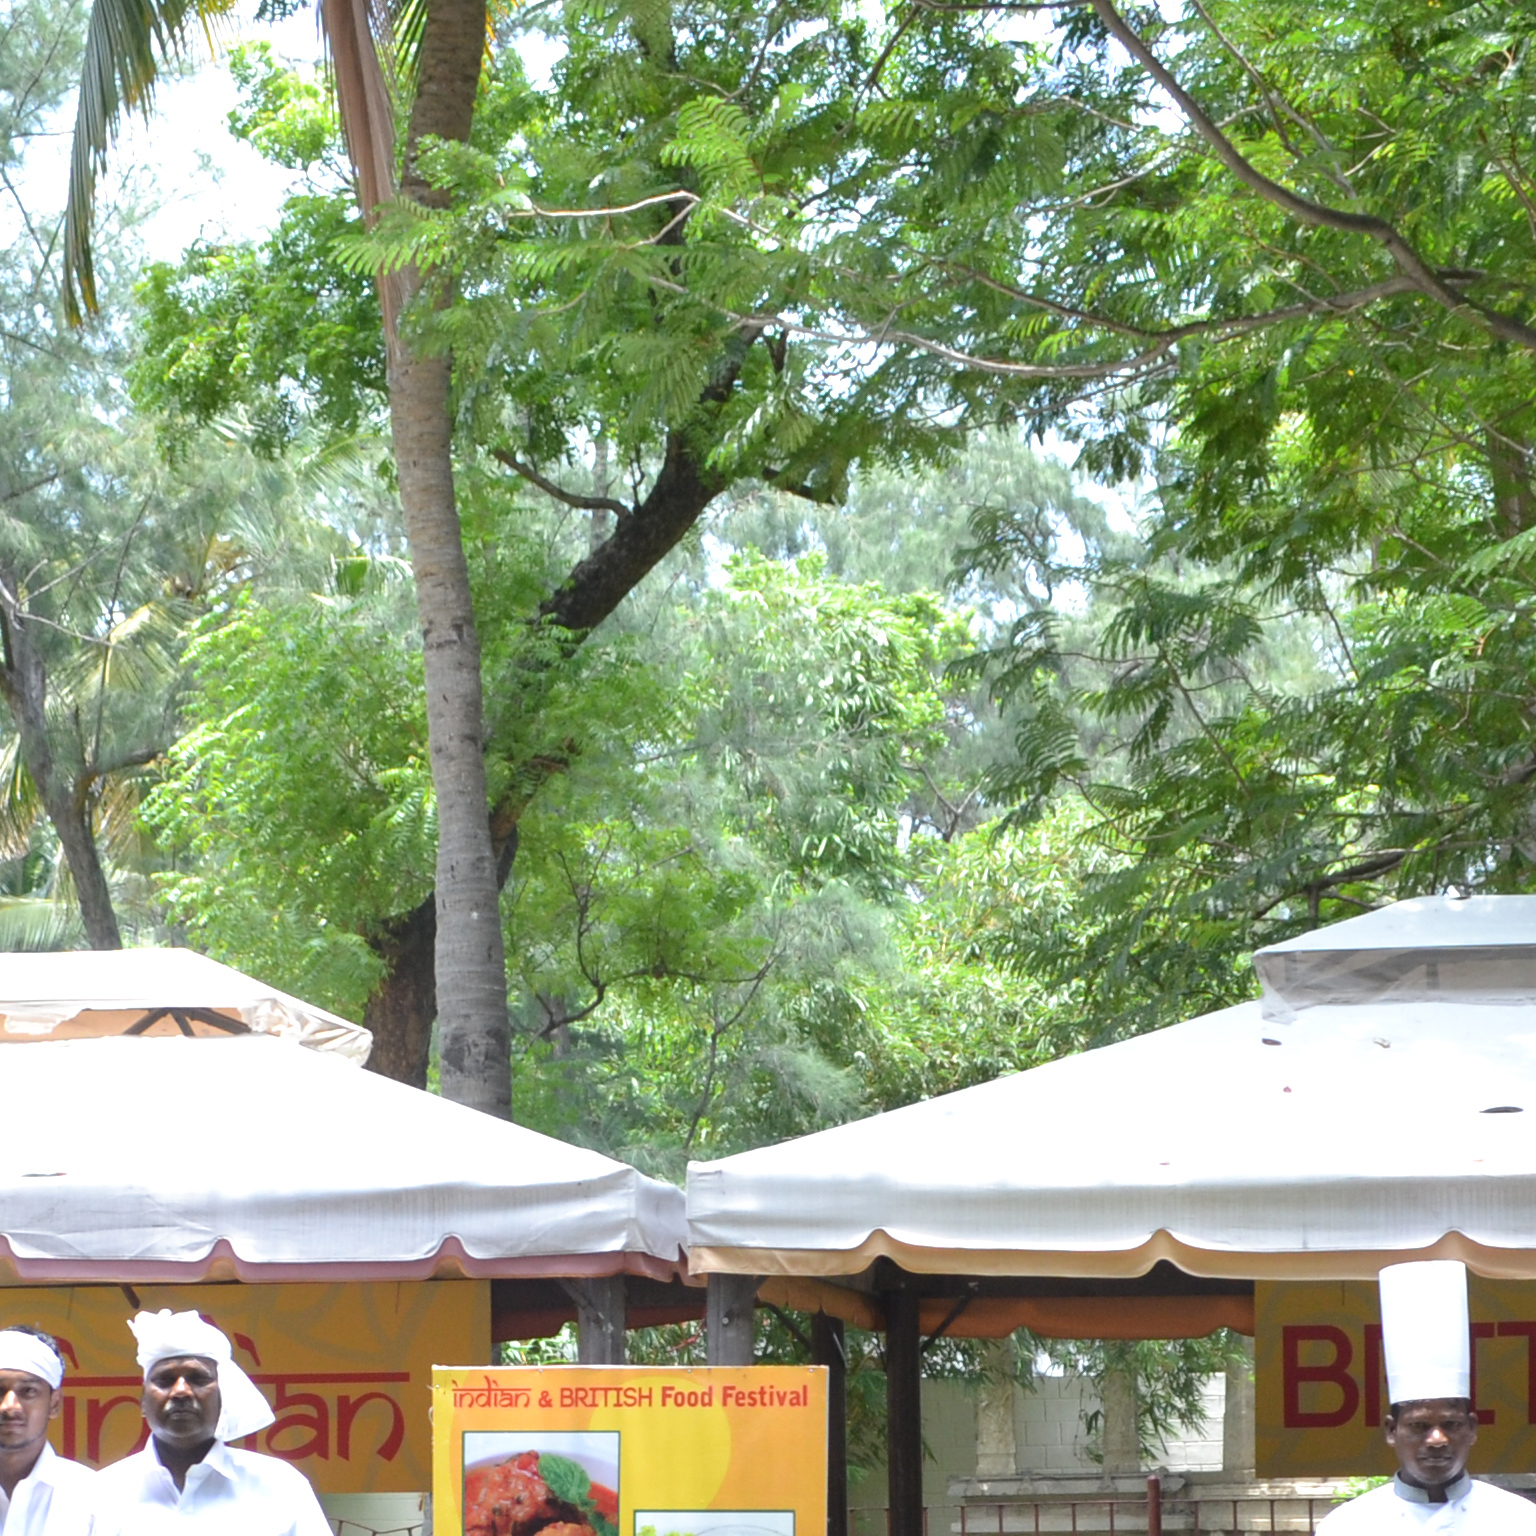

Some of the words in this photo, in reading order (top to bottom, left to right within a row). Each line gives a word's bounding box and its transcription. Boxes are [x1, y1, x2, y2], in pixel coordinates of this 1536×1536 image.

[539, 1391, 552, 1407] &
[560, 1387, 652, 1407] BRITISH
[661, 1386, 712, 1407] Food
[722, 1385, 808, 1407] Festival
